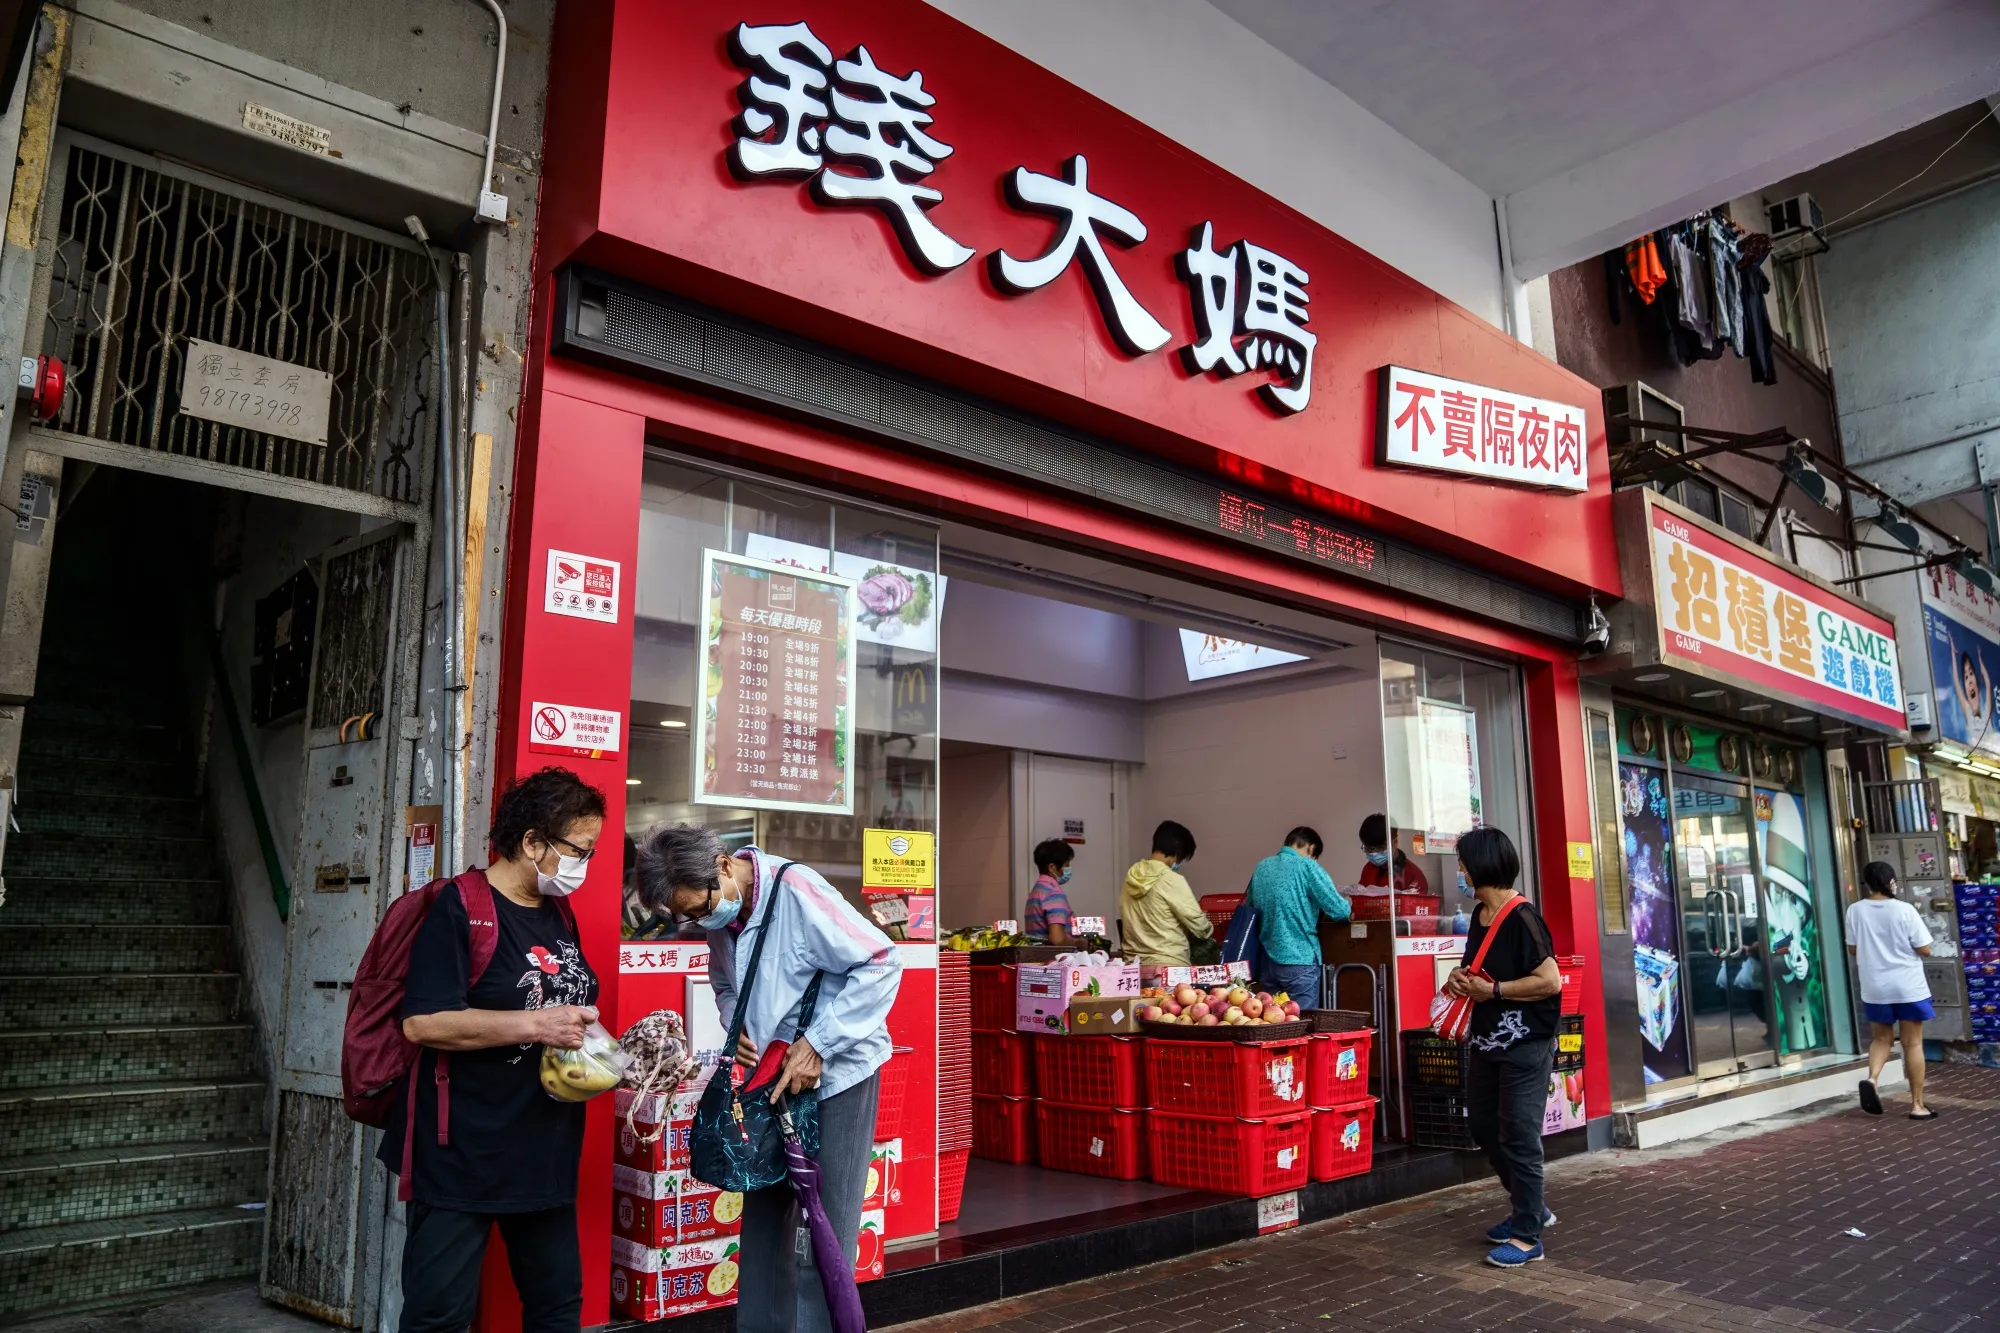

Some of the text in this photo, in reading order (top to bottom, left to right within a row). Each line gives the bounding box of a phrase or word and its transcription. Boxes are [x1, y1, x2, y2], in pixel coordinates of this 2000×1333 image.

[271, 129, 296, 144] 9486
[299, 140, 324, 154] 5797
[738, 20, 1318, 412] 錢大媽
[197, 354, 300, 394] 獨立套房
[199, 386, 301, 426] 98793998
[1394, 381, 1581, 476] 不賣隔夜肉
[1663, 519, 1689, 542] GAME
[1668, 541, 1815, 678] 招積堡
[740, 606, 822, 635] 每天優惠時段
[741, 632, 819, 654] 19:00 全場9折
[1676, 634, 1702, 654] GAME
[1817, 610, 1891, 667] GAME
[740, 646, 819, 667] 19:30 全場8折
[740, 660, 819, 681] 20:00 全場7折
[739, 675, 818, 695] 20:30 全場6折
[739, 689, 818, 709] 21:00 全場5折
[738, 704, 818, 723] 21:30 全場4折
[738, 718, 818, 738] 22:00 全場3折
[737, 733, 817, 752] 22:30 全場2折
[736, 747, 817, 766] 23:00 全場1折
[736, 762, 819, 780] 23:30 免費派送
[526, 952, 564, 967] 日本
[1078, 1013, 1087, 1022] 40
[622, 1130, 634, 1148] 頂
[620, 1204, 633, 1222] 頂
[663, 1199, 711, 1229] 阿克苏
[678, 1246, 713, 1264] 冰糖心
[613, 1276, 626, 1295] 頂
